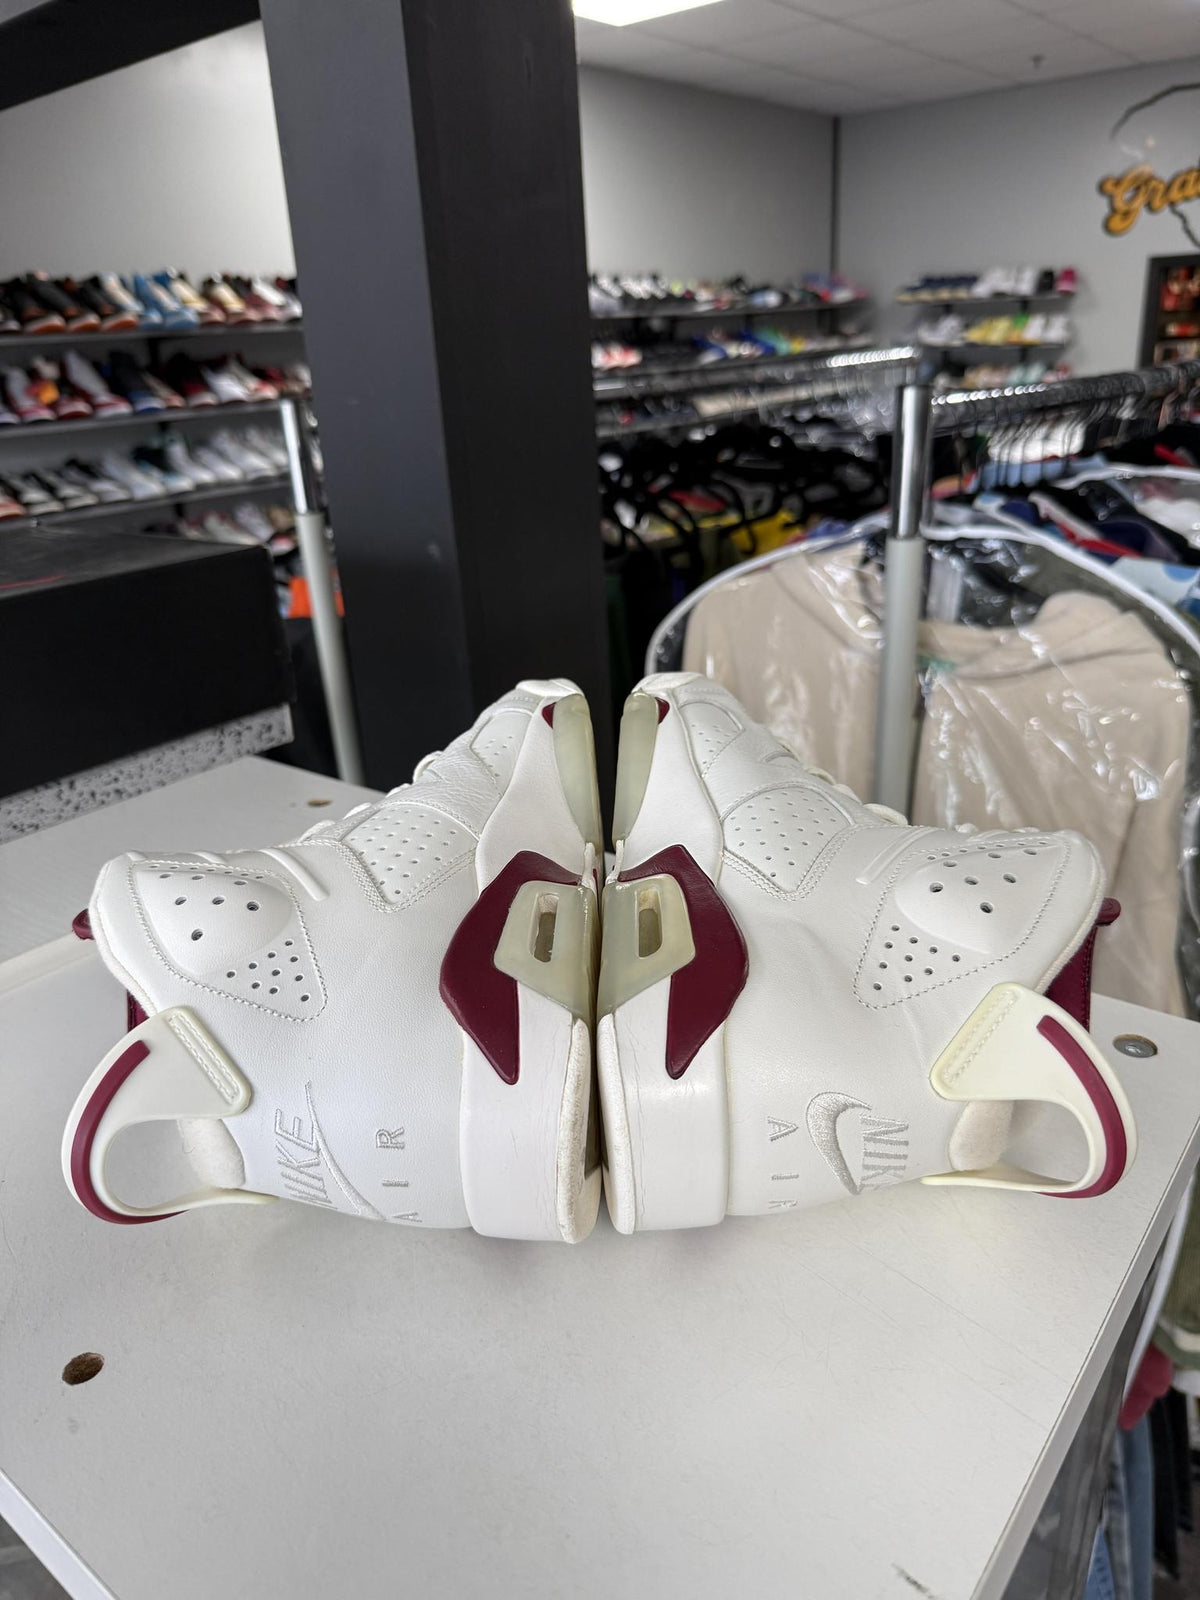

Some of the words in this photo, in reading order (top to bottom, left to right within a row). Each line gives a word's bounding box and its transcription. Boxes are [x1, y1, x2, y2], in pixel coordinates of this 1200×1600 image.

[275, 1108, 338, 1210] NIKE
[376, 1127, 423, 1223] AIR
[767, 1115, 799, 1209] AIR
